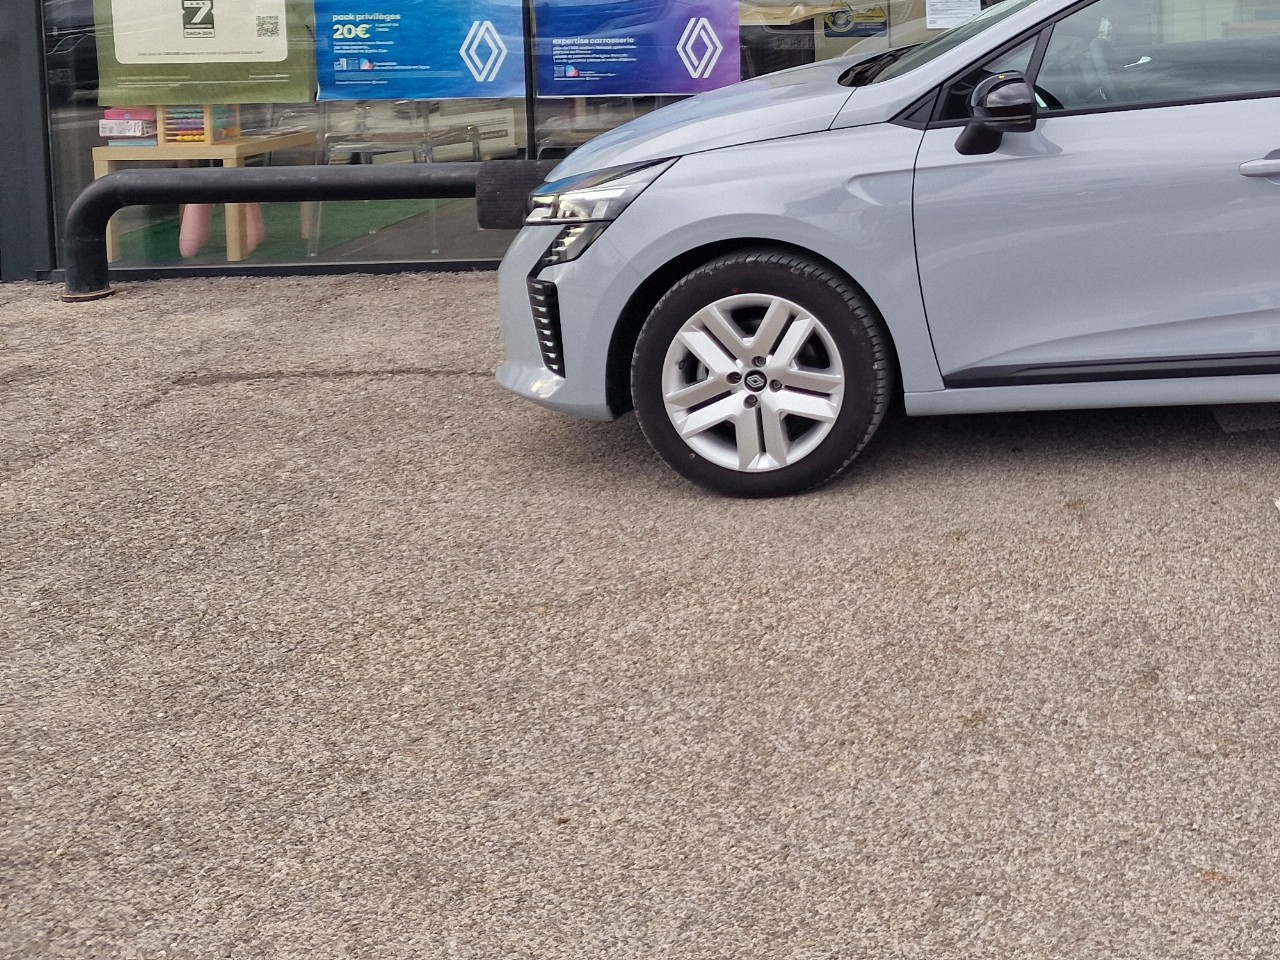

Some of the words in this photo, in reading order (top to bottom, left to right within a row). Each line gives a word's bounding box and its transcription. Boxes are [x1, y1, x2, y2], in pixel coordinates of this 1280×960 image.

[184, 0, 212, 23] 7
[332, 13, 355, 22] pack
[356, 13, 401, 22] privilèges
[553, 37, 589, 45] expertise
[590, 36, 635, 44] carrosserie
